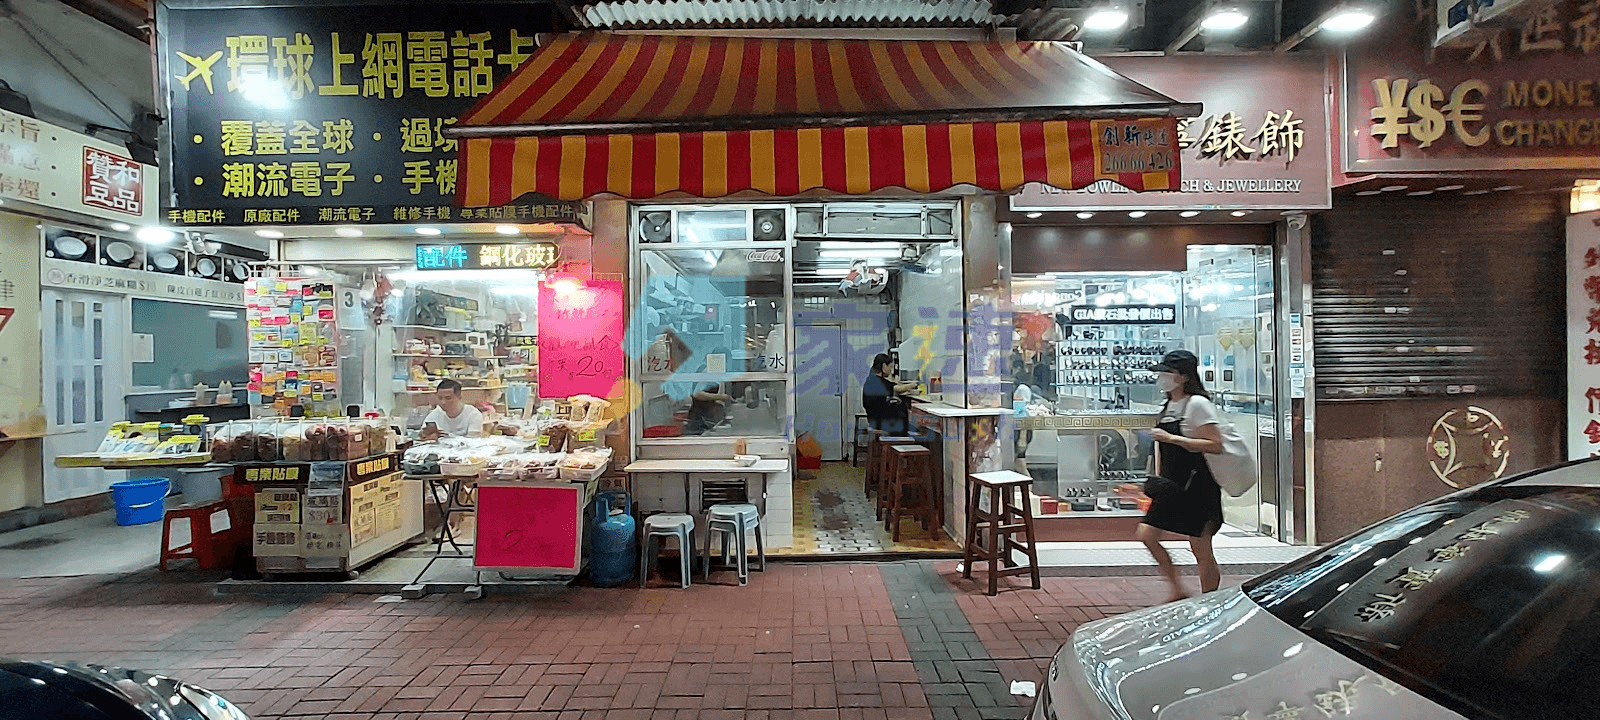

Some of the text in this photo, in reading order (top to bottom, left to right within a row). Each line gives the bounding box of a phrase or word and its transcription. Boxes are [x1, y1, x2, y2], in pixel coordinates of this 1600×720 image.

[1504, 80, 1600, 108] MONE
[220, 120, 354, 156] 覆蓋全球
[221, 162, 355, 199] 潮流電子
[1203, 180, 1215, 192] &
[1216, 180, 1302, 193] JEWELLERY
[168, 209, 226, 224] 手機配件
[243, 208, 300, 223] 原廠配件
[318, 207, 376, 222] 潮流電子
[393, 205, 451, 220] 維修手機
[344, 291, 354, 308] 3
